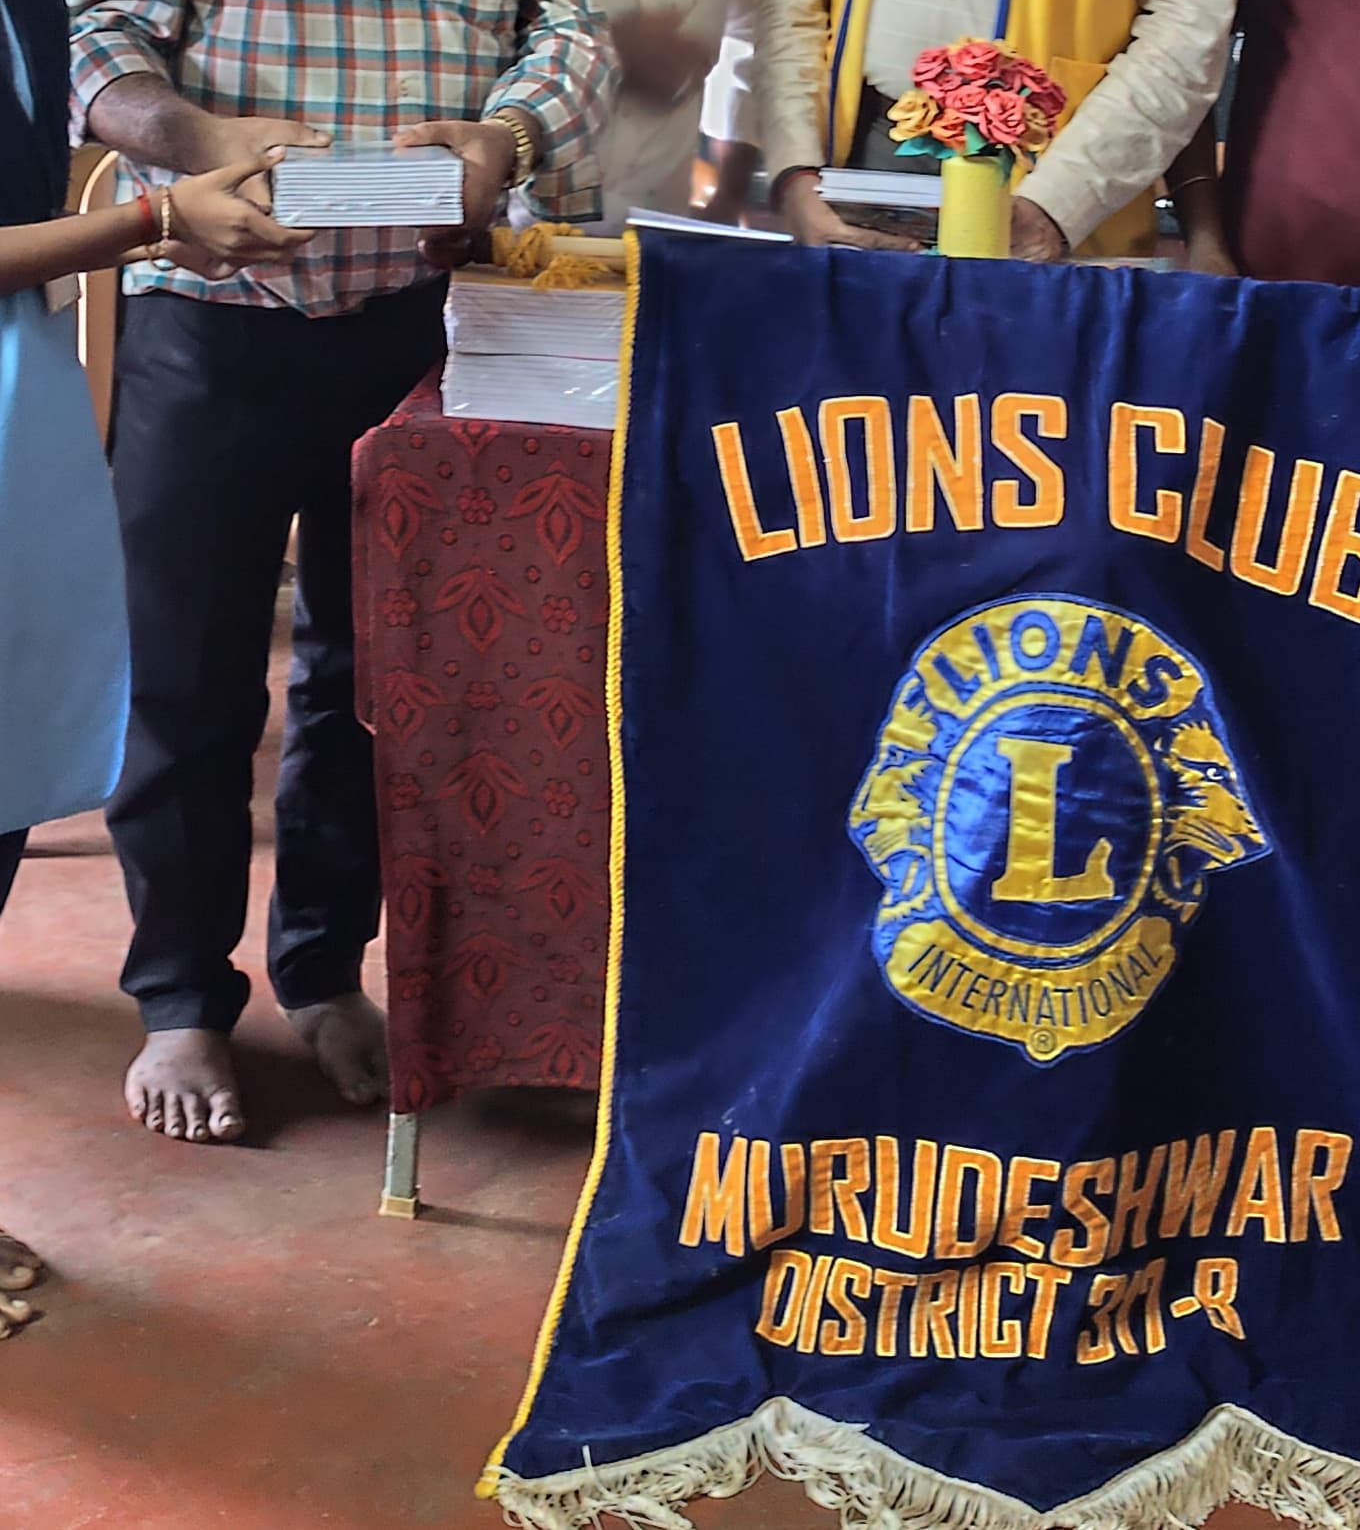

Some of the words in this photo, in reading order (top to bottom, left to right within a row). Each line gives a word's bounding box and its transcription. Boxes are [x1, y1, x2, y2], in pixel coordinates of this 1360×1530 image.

[711, 393, 1068, 561] LIONS
[930, 608, 1185, 707] LIONS
[992, 737, 1115, 902] L
[908, 942, 1166, 1027] INTERNATIONAL
[679, 1126, 1353, 1267] MURUDESHWAR
[755, 1249, 1071, 1359] DISTRICT
